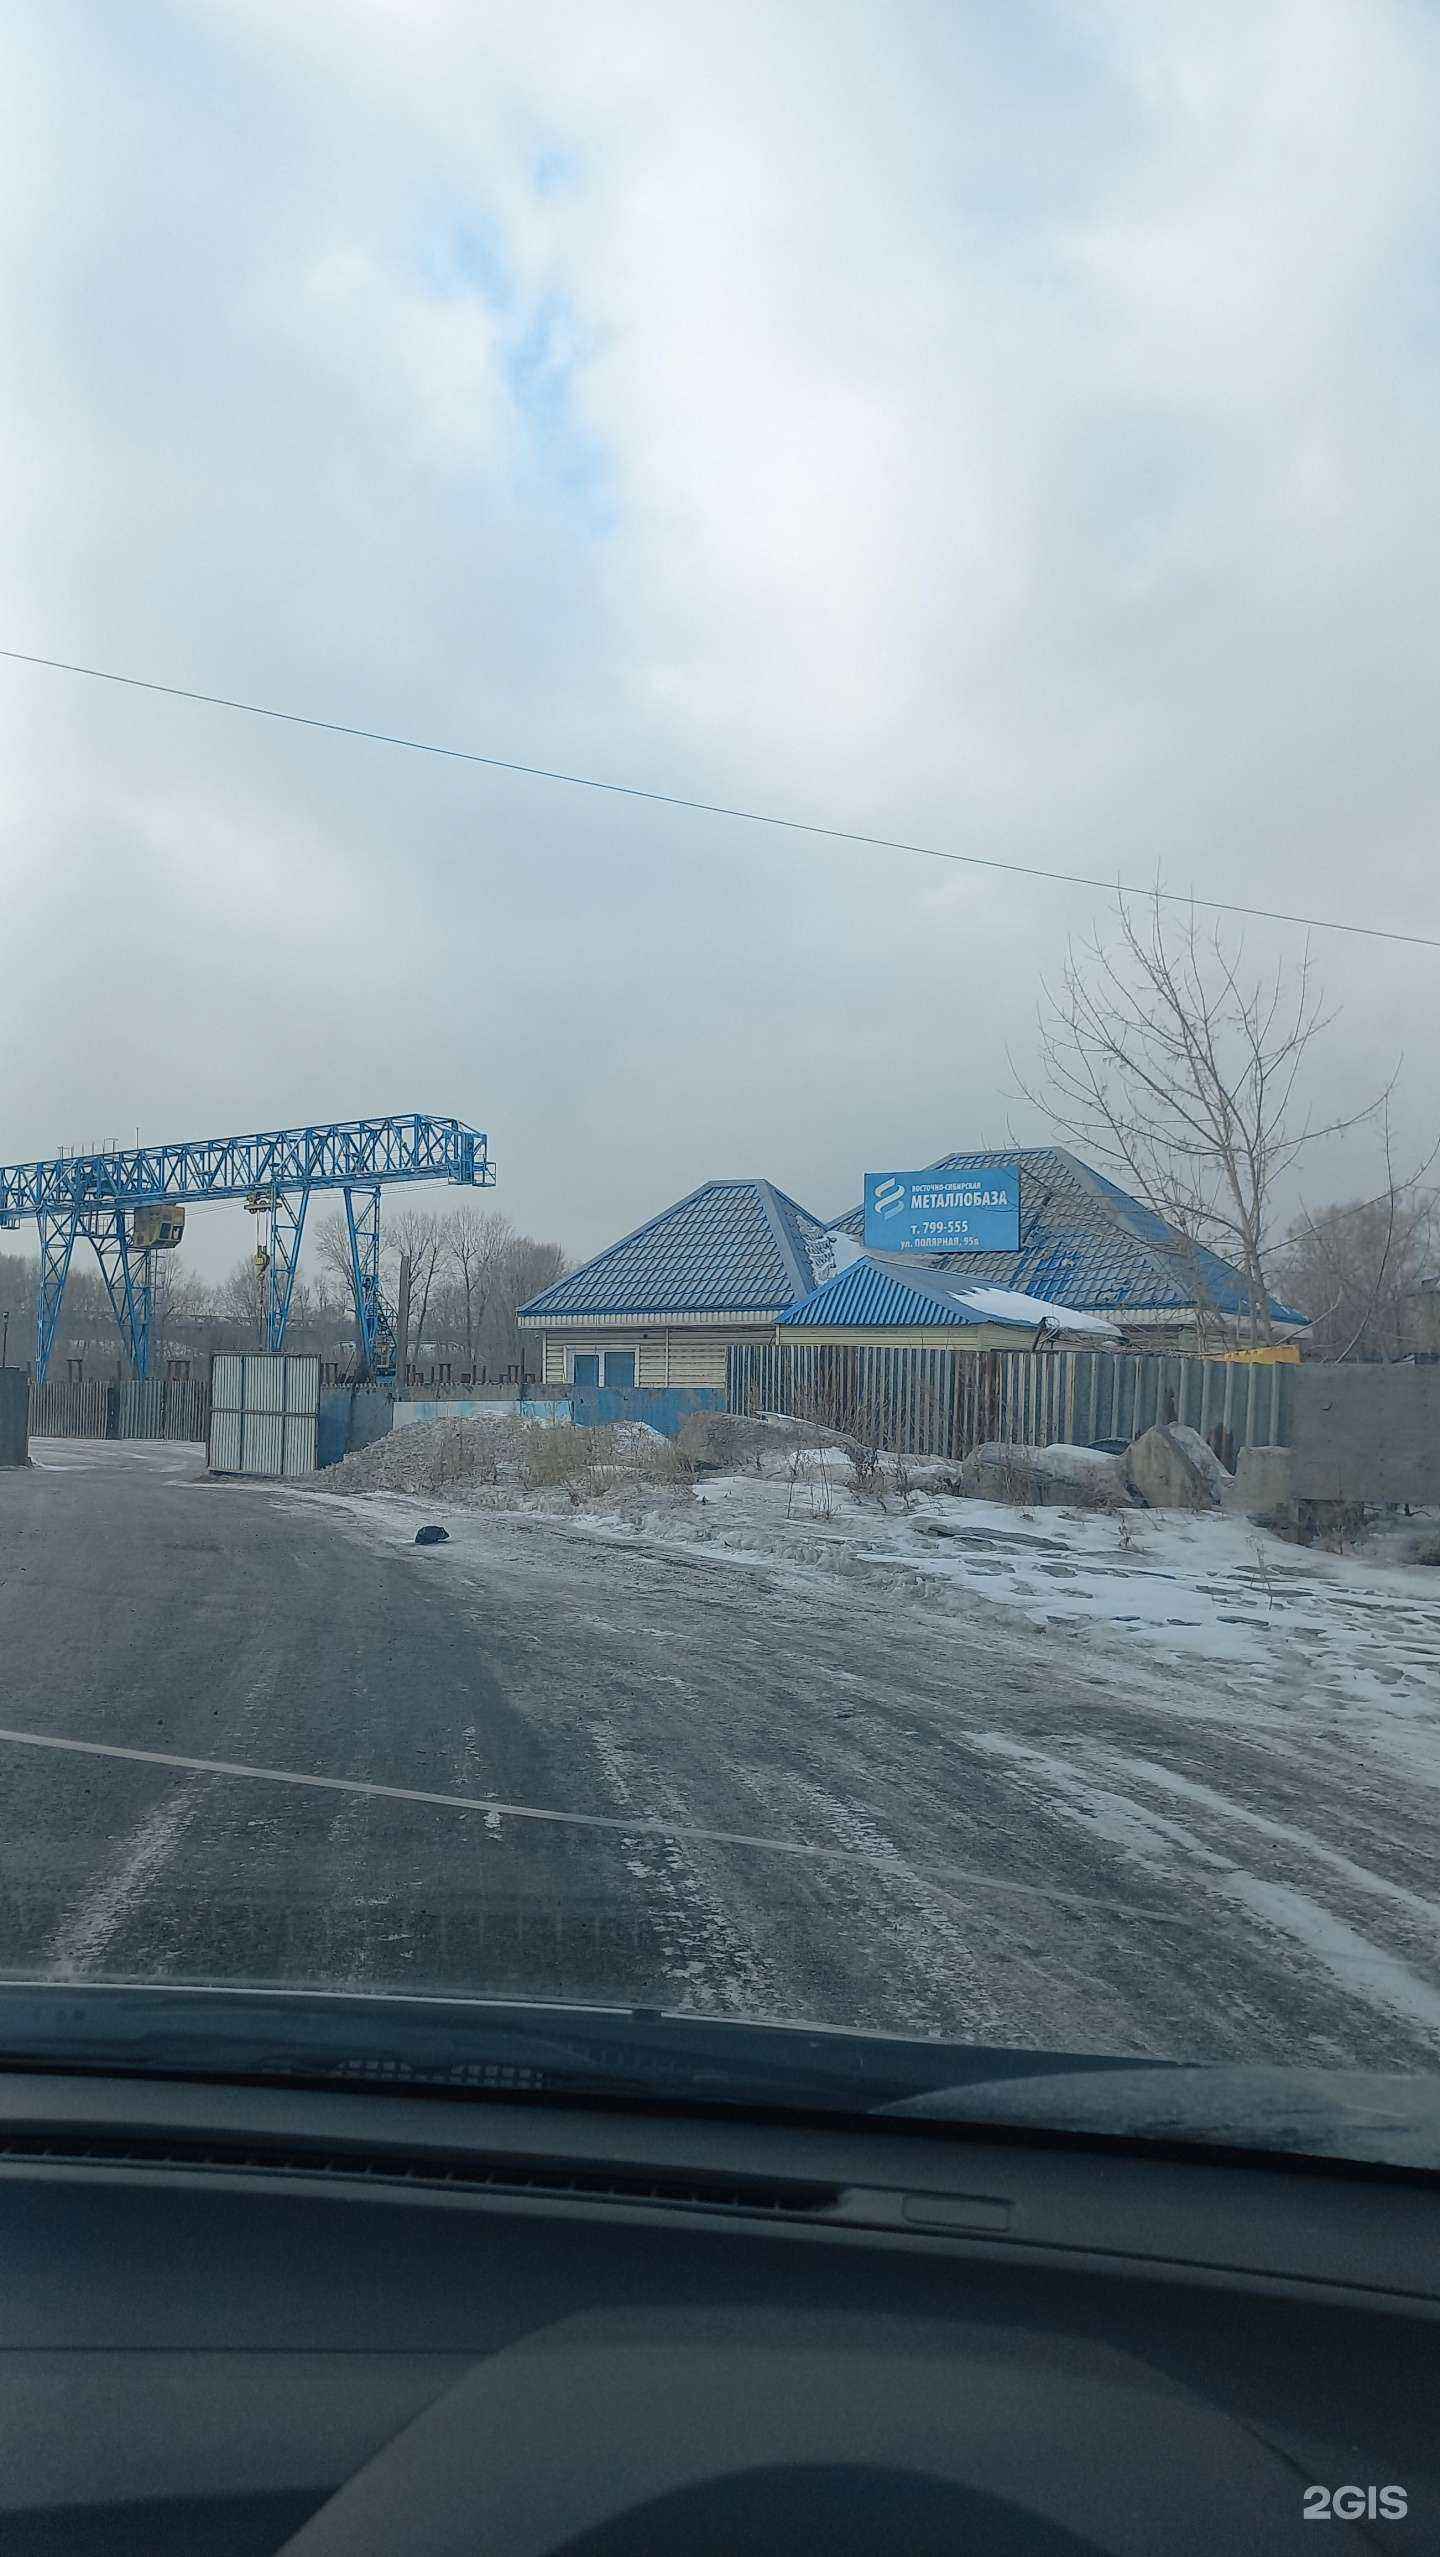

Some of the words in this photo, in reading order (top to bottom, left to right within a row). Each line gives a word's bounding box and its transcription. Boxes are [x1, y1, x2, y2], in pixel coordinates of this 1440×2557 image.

[912, 1182, 981, 1192] ВОСТОЧНО-СИБИРСКАЯ
[911, 1191, 1008, 1209] МЕТАЛЛОБАЗА
[922, 1220, 968, 1233] 799-555
[900, 1240, 913, 1250] ул.
